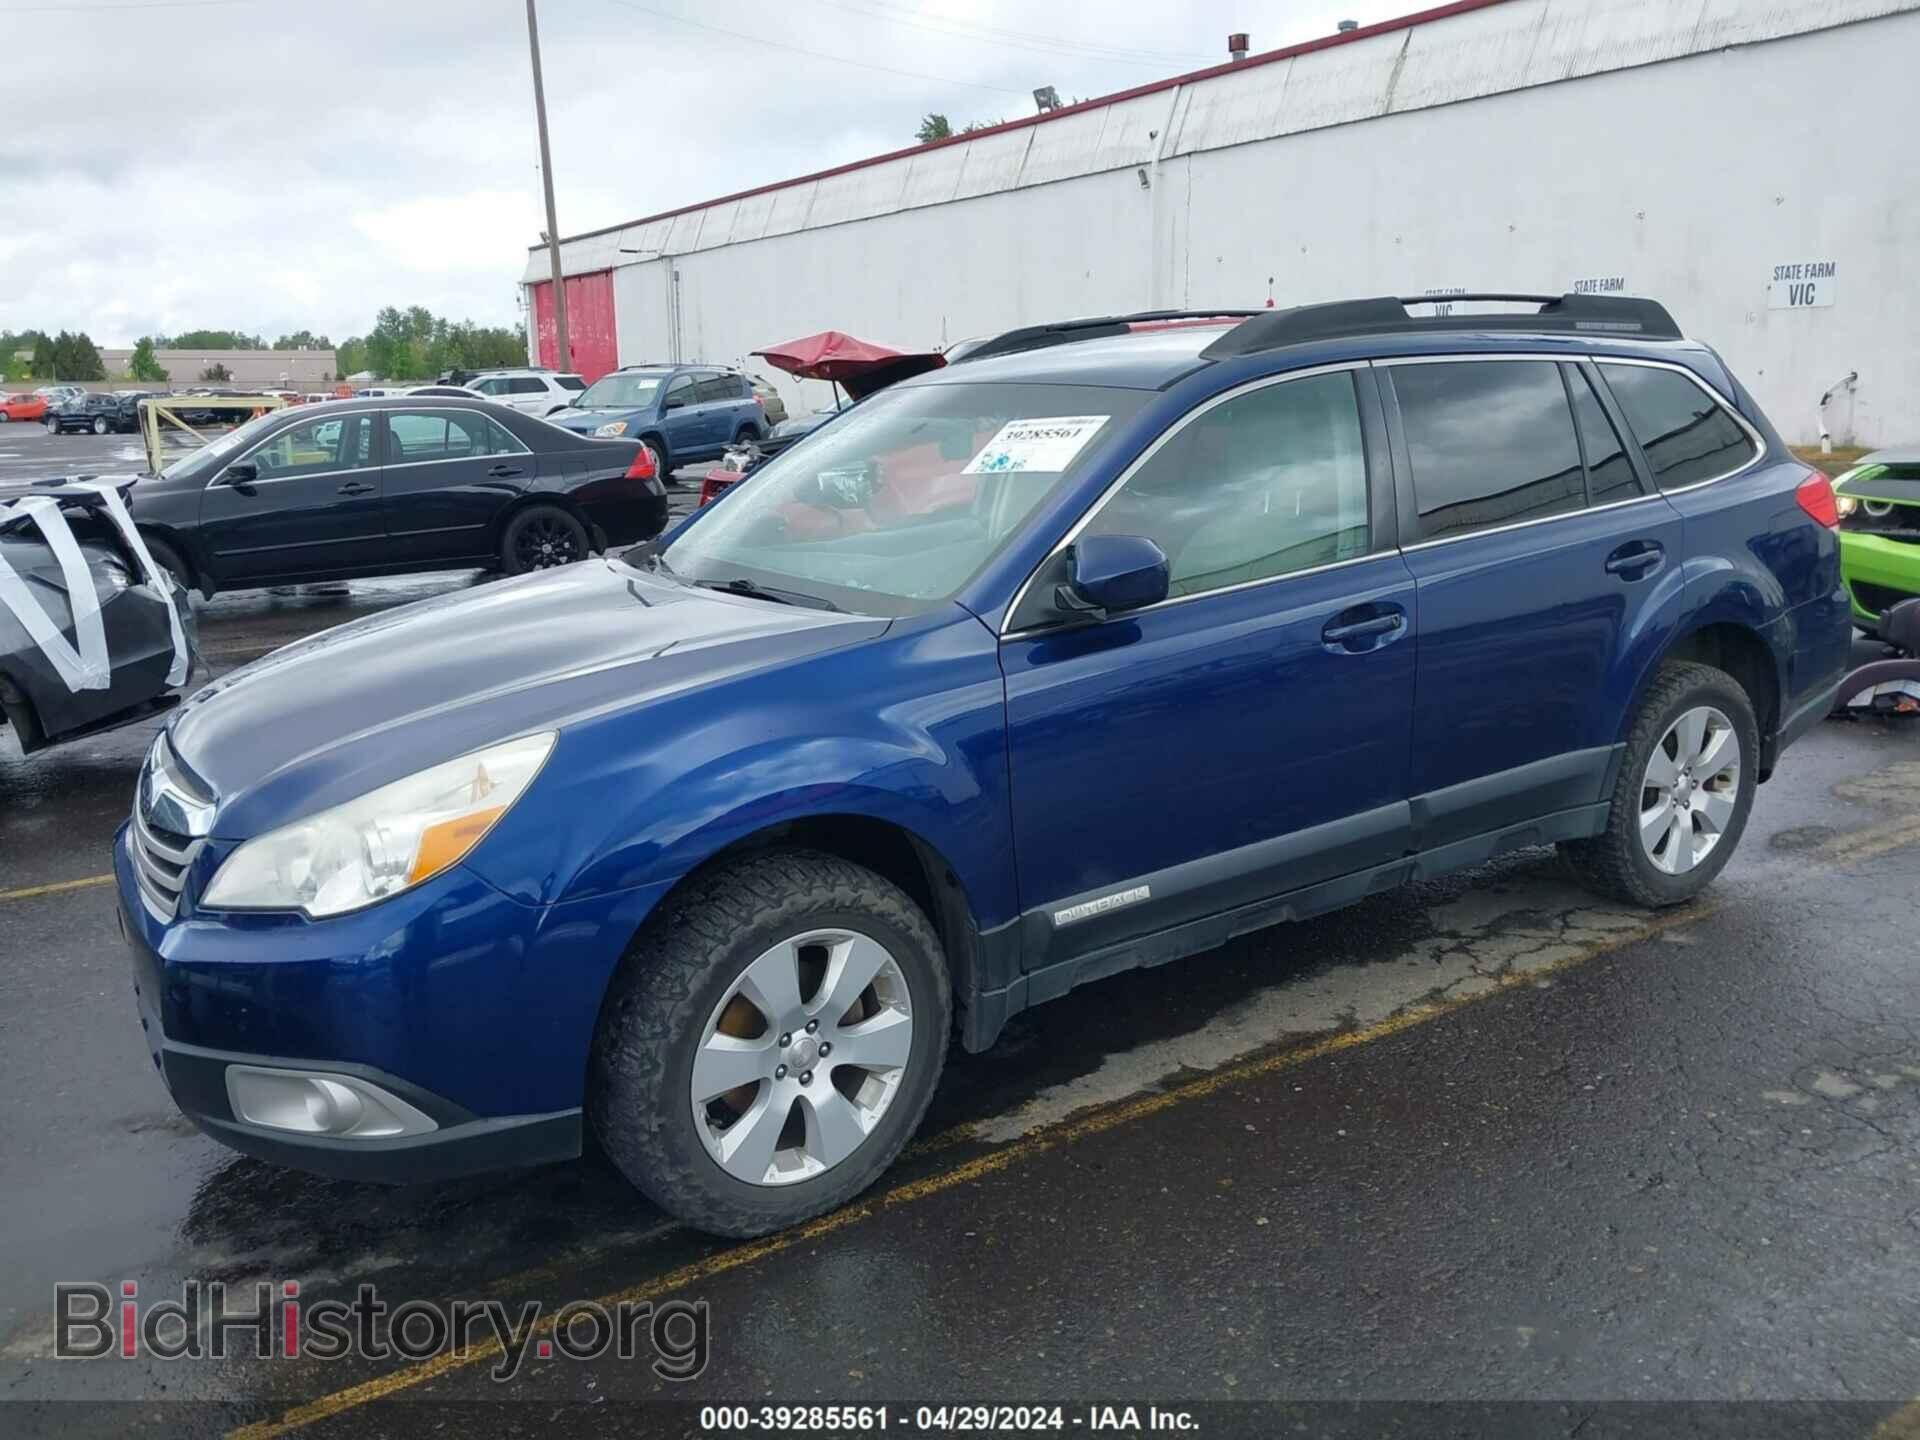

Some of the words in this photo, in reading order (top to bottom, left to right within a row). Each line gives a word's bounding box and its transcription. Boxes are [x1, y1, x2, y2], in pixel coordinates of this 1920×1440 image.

[1774, 264, 1802, 281] STATE
[1804, 261, 1836, 279] FARM
[1574, 279, 1597, 294] STATE
[1599, 277, 1625, 291] FARM
[1789, 282, 1816, 306] VIC
